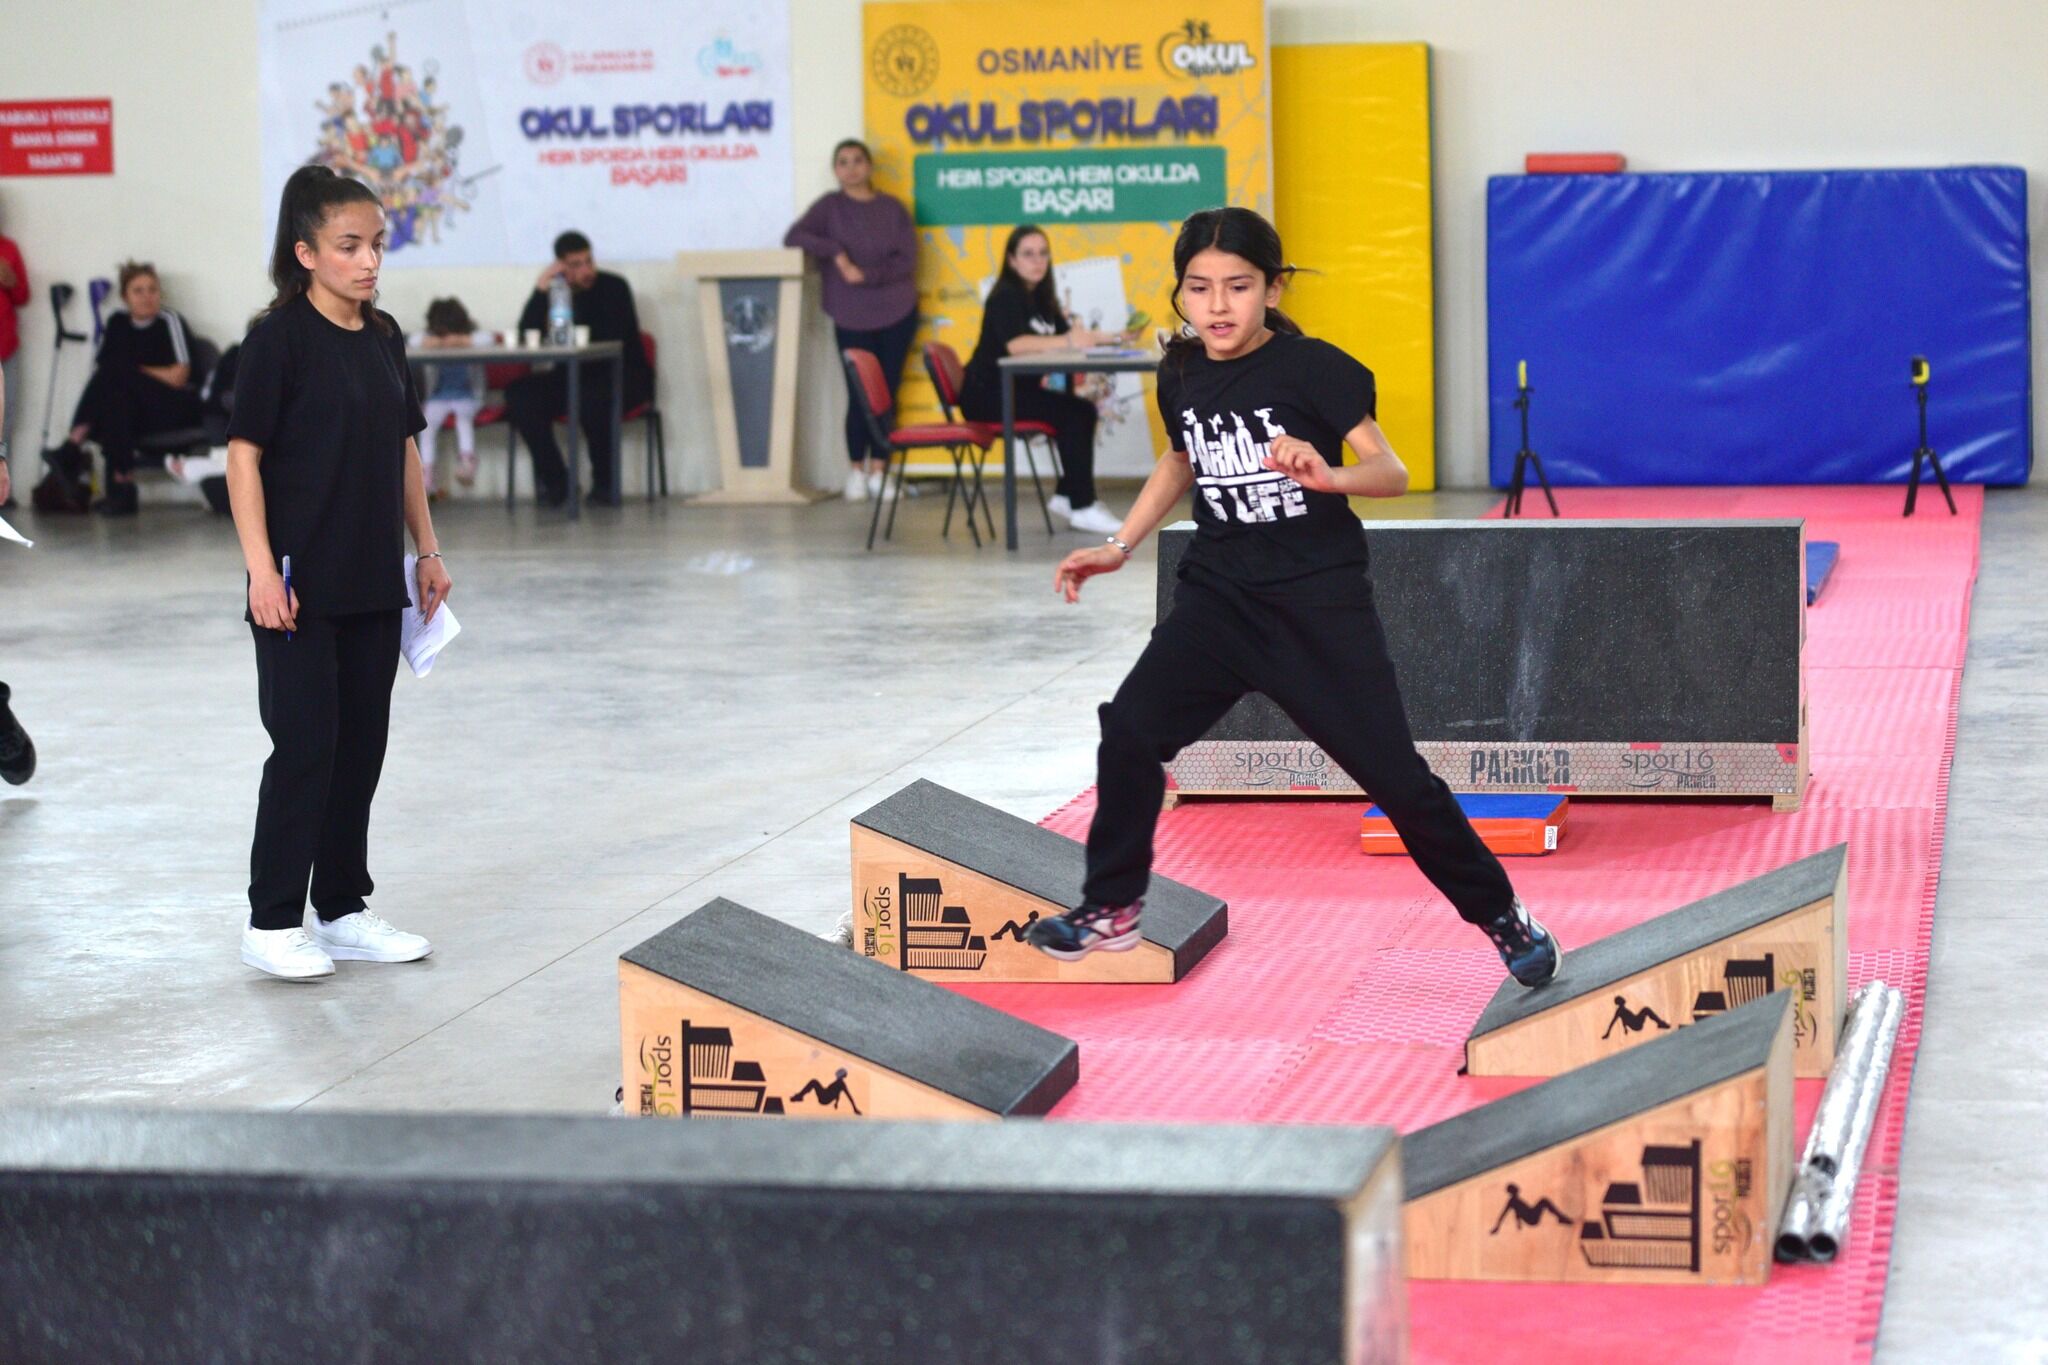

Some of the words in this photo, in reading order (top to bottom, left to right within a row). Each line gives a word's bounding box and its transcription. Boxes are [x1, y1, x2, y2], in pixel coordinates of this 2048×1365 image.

[977, 38, 1143, 75] OSMANİYE
[1172, 43, 1256, 69] OKUL
[518, 103, 607, 139] OKUL
[612, 100, 773, 138] SPORLARI
[904, 100, 1013, 144] OKUL
[1017, 94, 1220, 141] SPORLARI
[610, 163, 687, 187] BAŞARI
[938, 168, 983, 189] HEM
[986, 166, 1066, 188] SPORDA
[1069, 164, 1114, 185] HEM
[1116, 162, 1200, 184] OKULDA
[1022, 187, 1115, 217] BAŞARI
